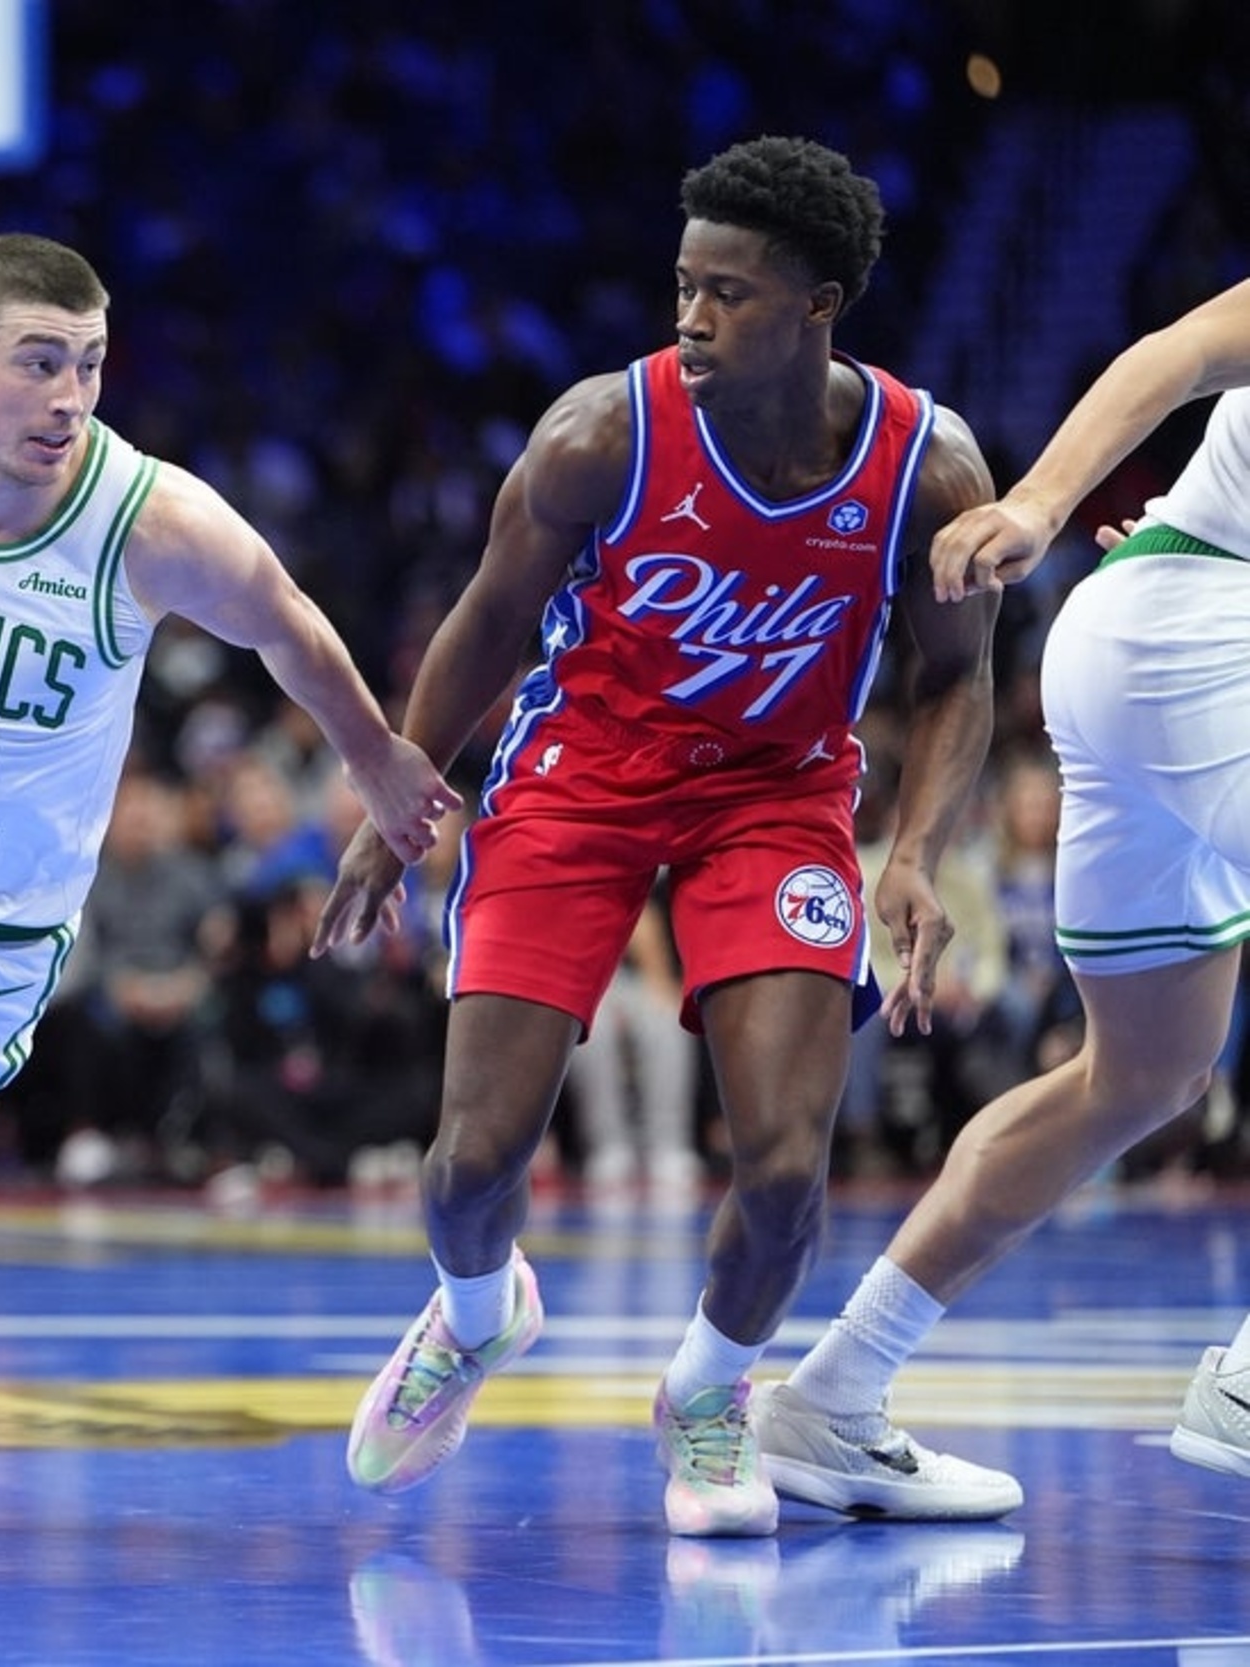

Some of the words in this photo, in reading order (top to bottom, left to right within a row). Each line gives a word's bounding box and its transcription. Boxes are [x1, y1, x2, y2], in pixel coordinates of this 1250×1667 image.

[18, 571, 87, 601] Amica
[616, 553, 855, 647] Phila
[661, 641, 826, 722] 77
